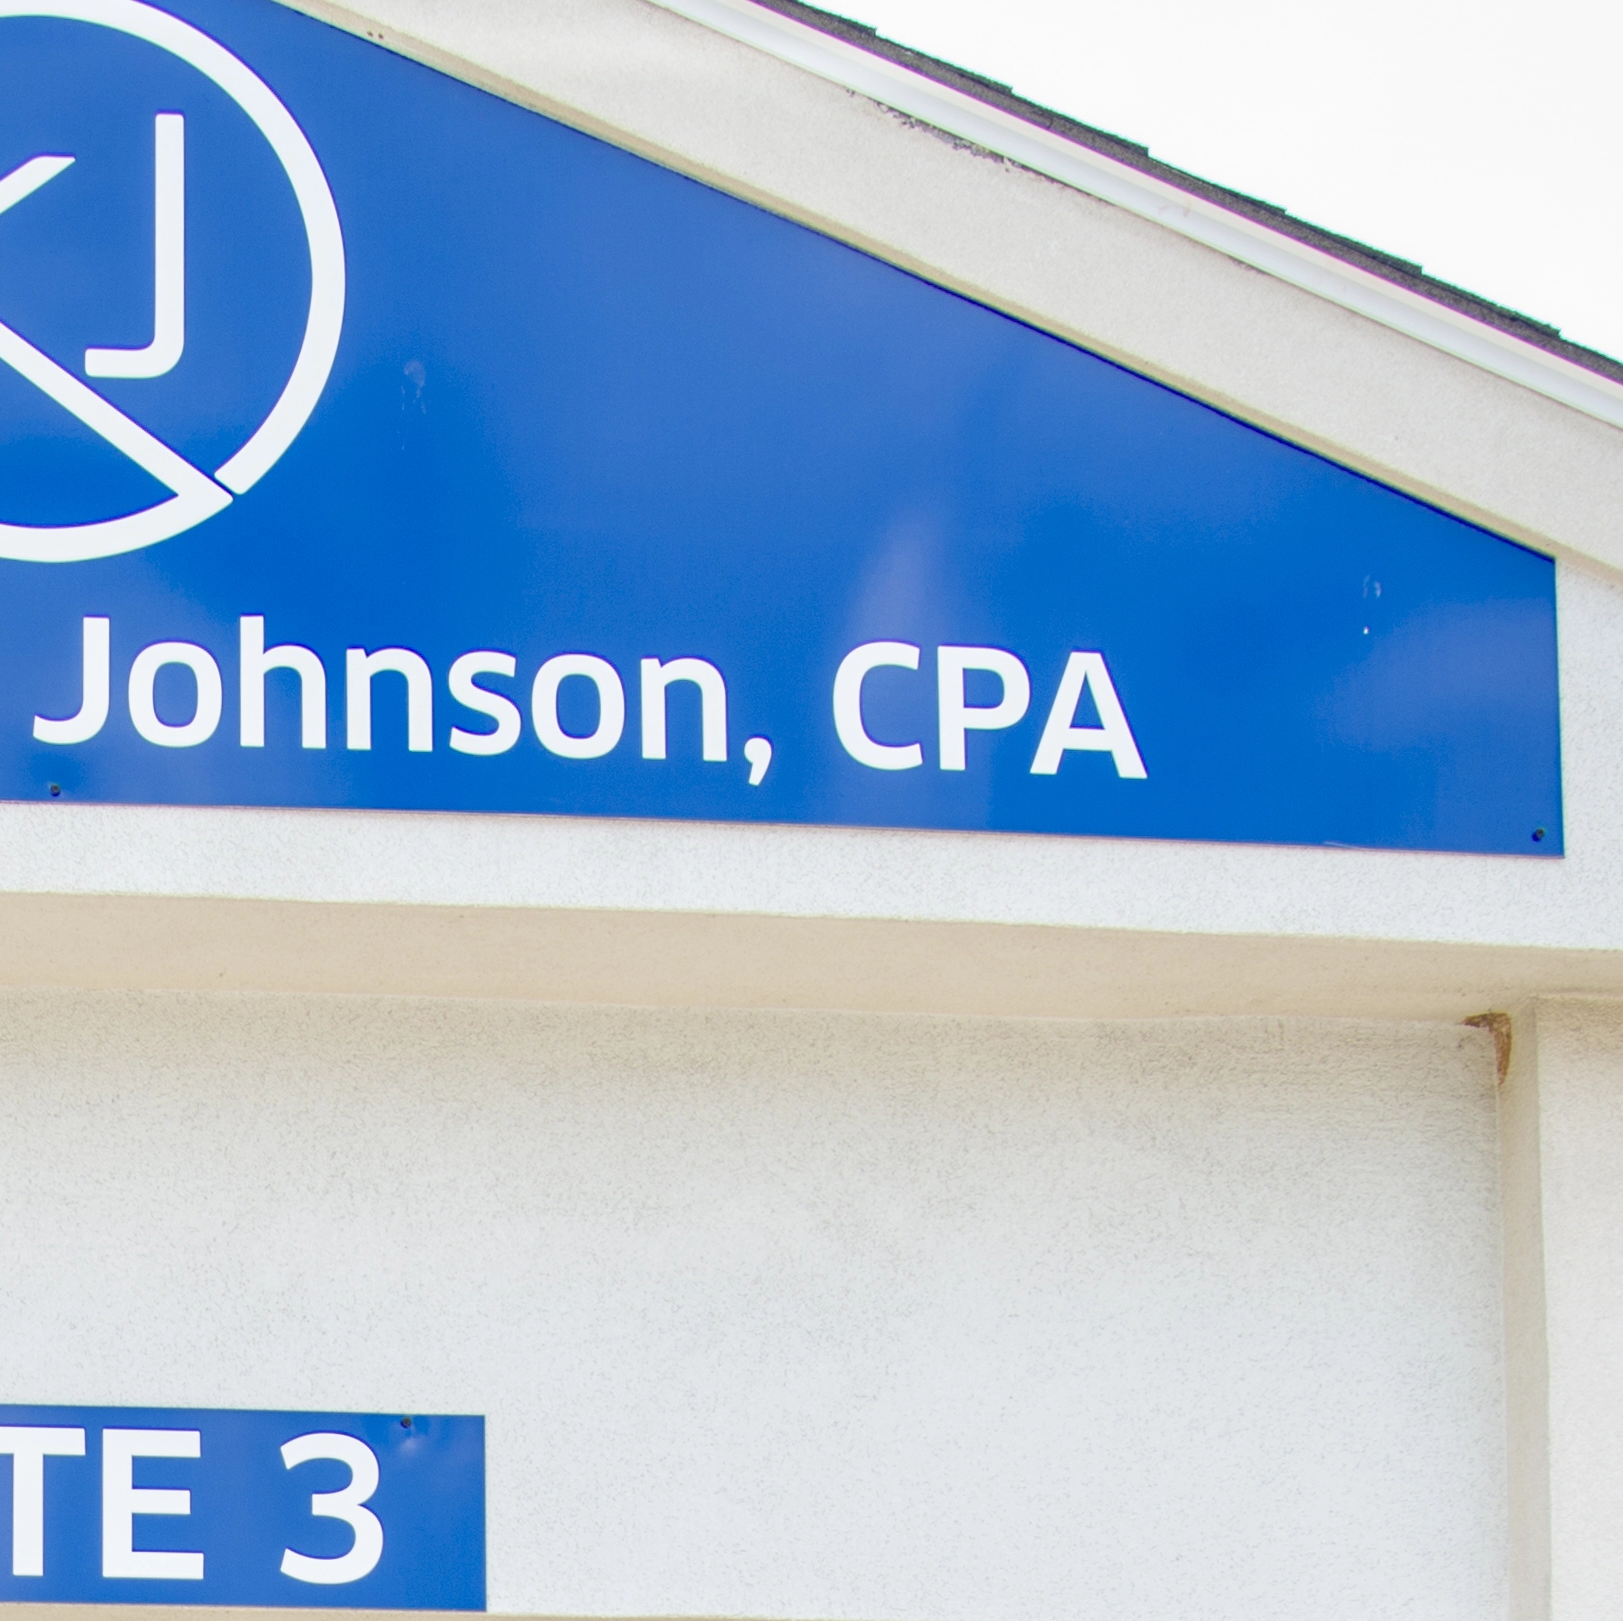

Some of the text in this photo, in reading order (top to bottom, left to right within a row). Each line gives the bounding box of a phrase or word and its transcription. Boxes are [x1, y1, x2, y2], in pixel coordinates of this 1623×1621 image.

[32, 615, 772, 786] Johnson,
[833, 641, 1148, 779] CPA
[280, 1432, 384, 1585] 3
